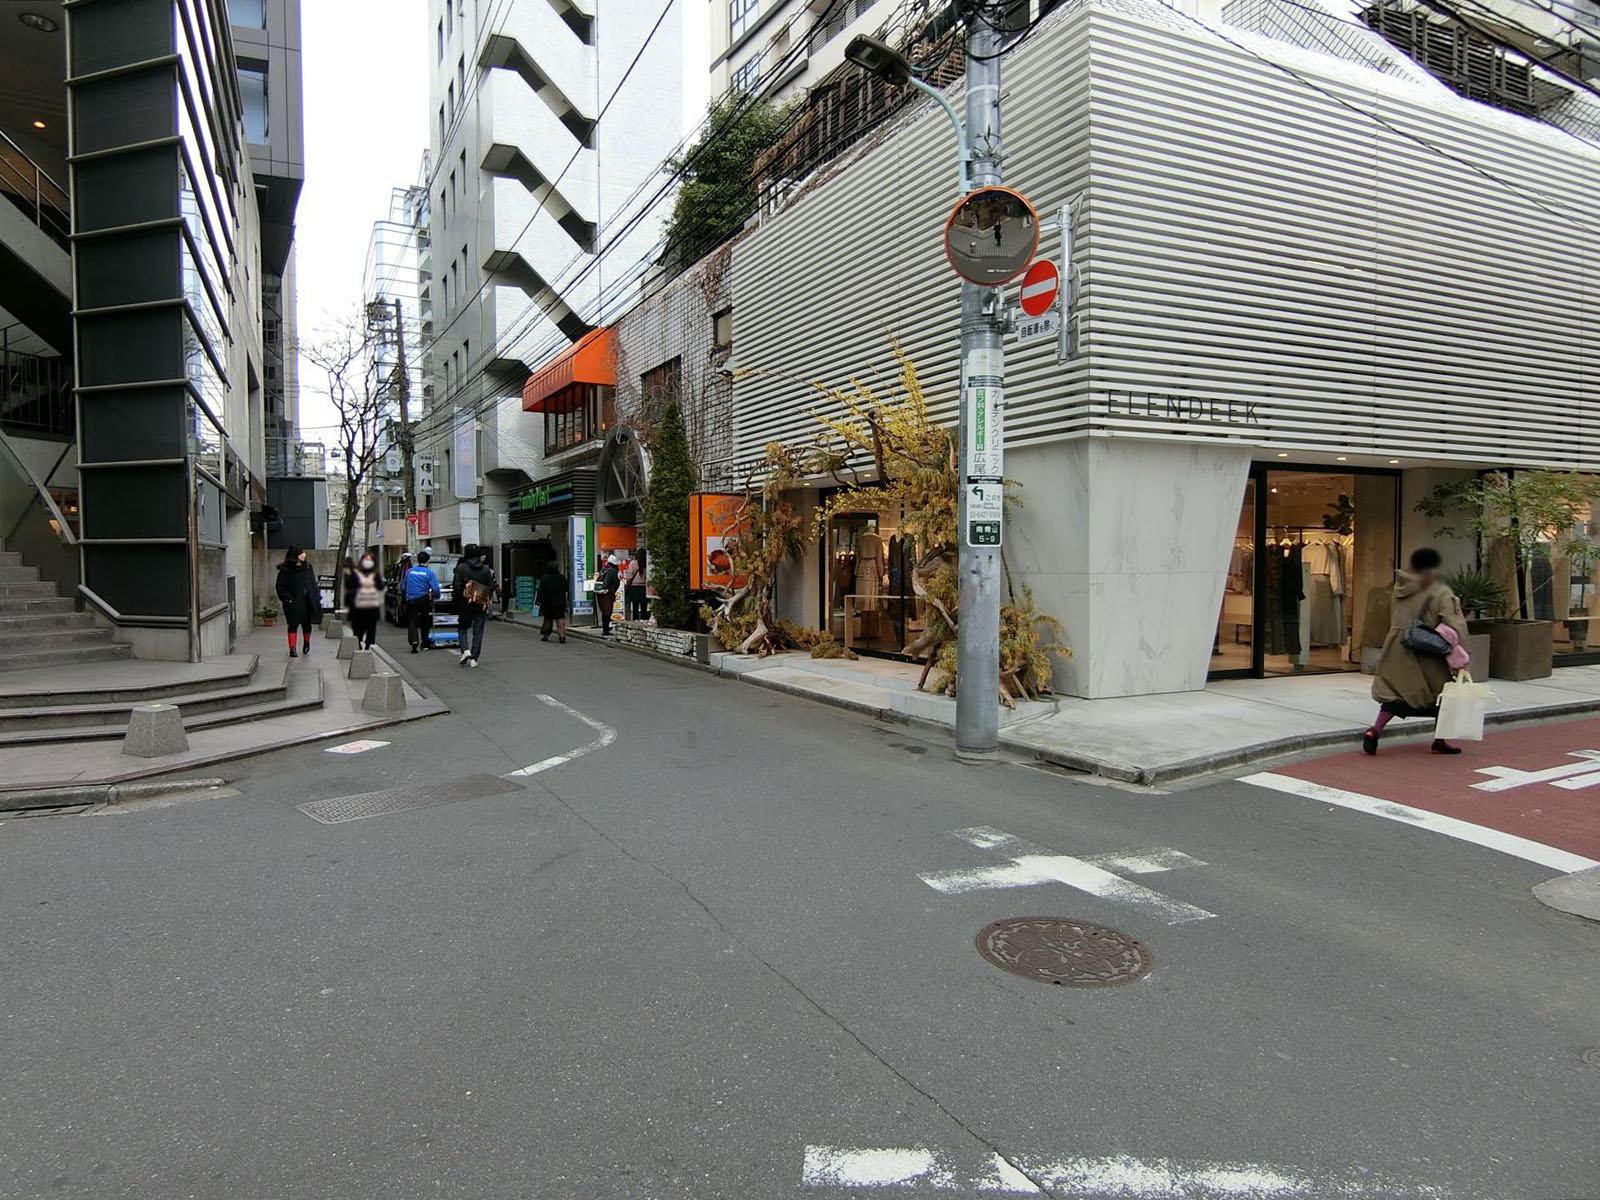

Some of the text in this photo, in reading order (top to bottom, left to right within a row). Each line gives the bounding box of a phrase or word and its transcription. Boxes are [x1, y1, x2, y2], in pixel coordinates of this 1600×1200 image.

[1108, 389, 1258, 424] ELENDEEK
[974, 452, 986, 474] 広尾
[518, 484, 550, 512] FamilyMart
[979, 535, 995, 543] 5-9
[576, 534, 585, 583] FamilyMart
